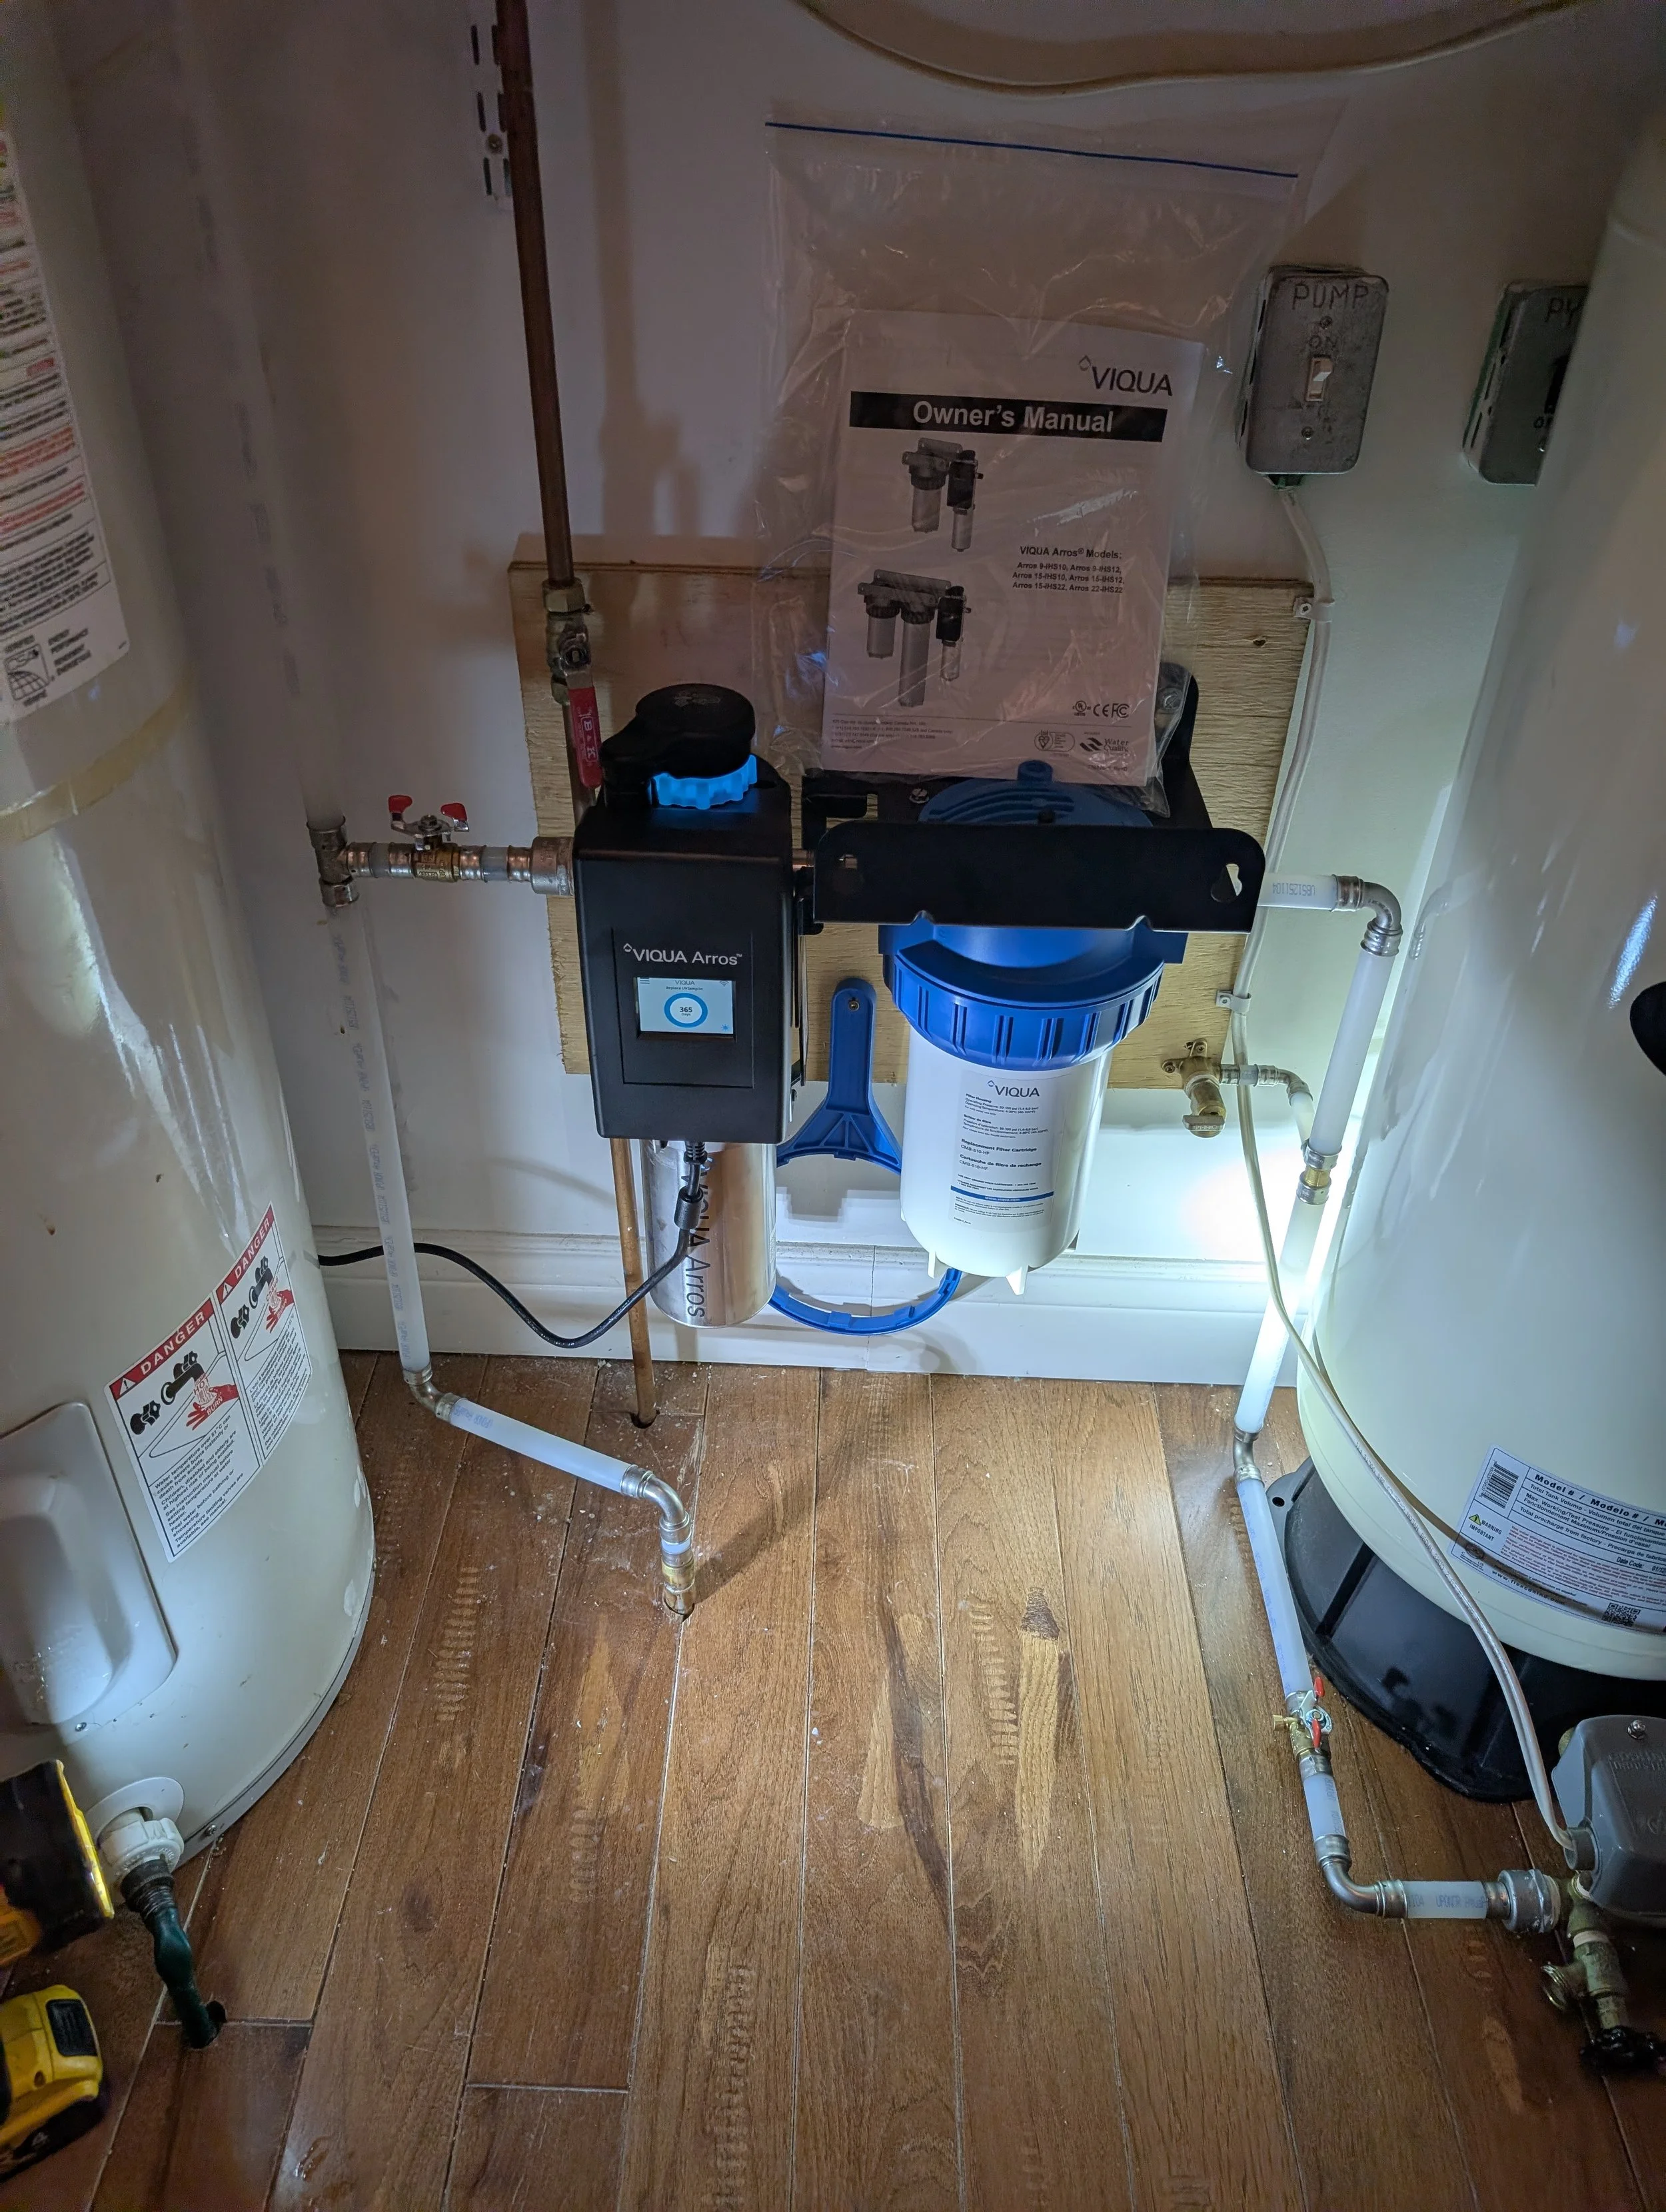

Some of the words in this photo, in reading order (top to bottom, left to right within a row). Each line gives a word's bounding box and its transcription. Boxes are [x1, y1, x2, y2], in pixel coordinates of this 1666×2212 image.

[1291, 284, 1370, 310] PUMP
[1092, 366, 1173, 396] VIQUA
[913, 400, 1014, 428] Owner's
[1024, 406, 1114, 432] Manual
[1020, 546, 1049, 556] VIQUA
[632, 948, 688, 963] VIQUA
[995, 1085, 1040, 1097] VIQUA
[960, 1154, 986, 1165] Cartouche
[961, 1139, 995, 1151] Replacement
[235, 1218, 270, 1279] DANGER
[141, 1311, 205, 1375] DANGER
[207, 1395, 223, 1415] BURN
[155, 1475, 171, 1489] Water
[171, 1448, 200, 1476] temperature
[201, 1437, 211, 1448] over
[157, 1480, 173, 1494] cause
[174, 1464, 191, 1480] severe
[191, 1450, 205, 1465] burns
[205, 1429, 223, 1451] instantly
[159, 1485, 174, 1499] death
[174, 1474, 187, 1486] from
[187, 1459, 204, 1474] scalds.
[161, 1485, 185, 1505] Children,
[185, 1464, 205, 1484] disabled
[205, 1454, 215, 1464] and
[215, 1439, 229, 1455] elderly
[169, 1486, 189, 1506] highest
[189, 1478, 199, 1488] risk
[204, 1458, 217, 1473] being
[217, 1440, 235, 1459] scalded.
[165, 1507, 175, 1517] See
[176, 1482, 203, 1507] instruction
[203, 1464, 220, 1483] manual
[219, 1449, 233, 1466] before
[167, 1505, 185, 1522] setting
[185, 1478, 214, 1506] temperature
[219, 1459, 231, 1472] water
[1534, 1474, 1566, 1493] Model
[1590, 1498, 1630, 1516] Modelo
[169, 1511, 187, 1526] heater.
[171, 1521, 183, 1532] Feel
[183, 1508, 197, 1522] water
[197, 1493, 213, 1509] before
[212, 1475, 229, 1494] bathing
[175, 1514, 206, 1542] Temperature
[205, 1496, 223, 1514] limiting
[223, 1481, 237, 1497] valves
[177, 1526, 201, 1548] available,
[201, 1516, 209, 1526] see
[209, 1499, 227, 1517] manual.
[1523, 1497, 1569, 1522] Fonctionnement
[1571, 1519, 1627, 1542] Maximum/Pression
[1525, 1493, 1540, 1502] Max.
[1541, 1500, 1581, 1521] Working/Test
[1581, 1517, 1609, 1531] Pressure
[1530, 1483, 1545, 1494] Total
[1545, 1490, 1559, 1501] Tank
[1560, 1498, 1583, 1511] Volume
[1588, 1510, 1614, 1522] Volumen
[1616, 1518, 1631, 1528] total
[1643, 1527, 1665, 1536] tanque
[173, 1512, 200, 1538] showering.
[1469, 1523, 1495, 1542] IMPORTANT
[1481, 1519, 1502, 1535] WARNING
[1520, 1506, 1533, 1516] Total
[1534, 1514, 1564, 1530] precharge
[1565, 1526, 1579, 1536] from
[1581, 1534, 1602, 1545] factory
[1607, 1543, 1635, 1555] Precarga
[1616, 1556, 1628, 1564] Date
[1629, 1560, 1644, 1569] Code:
